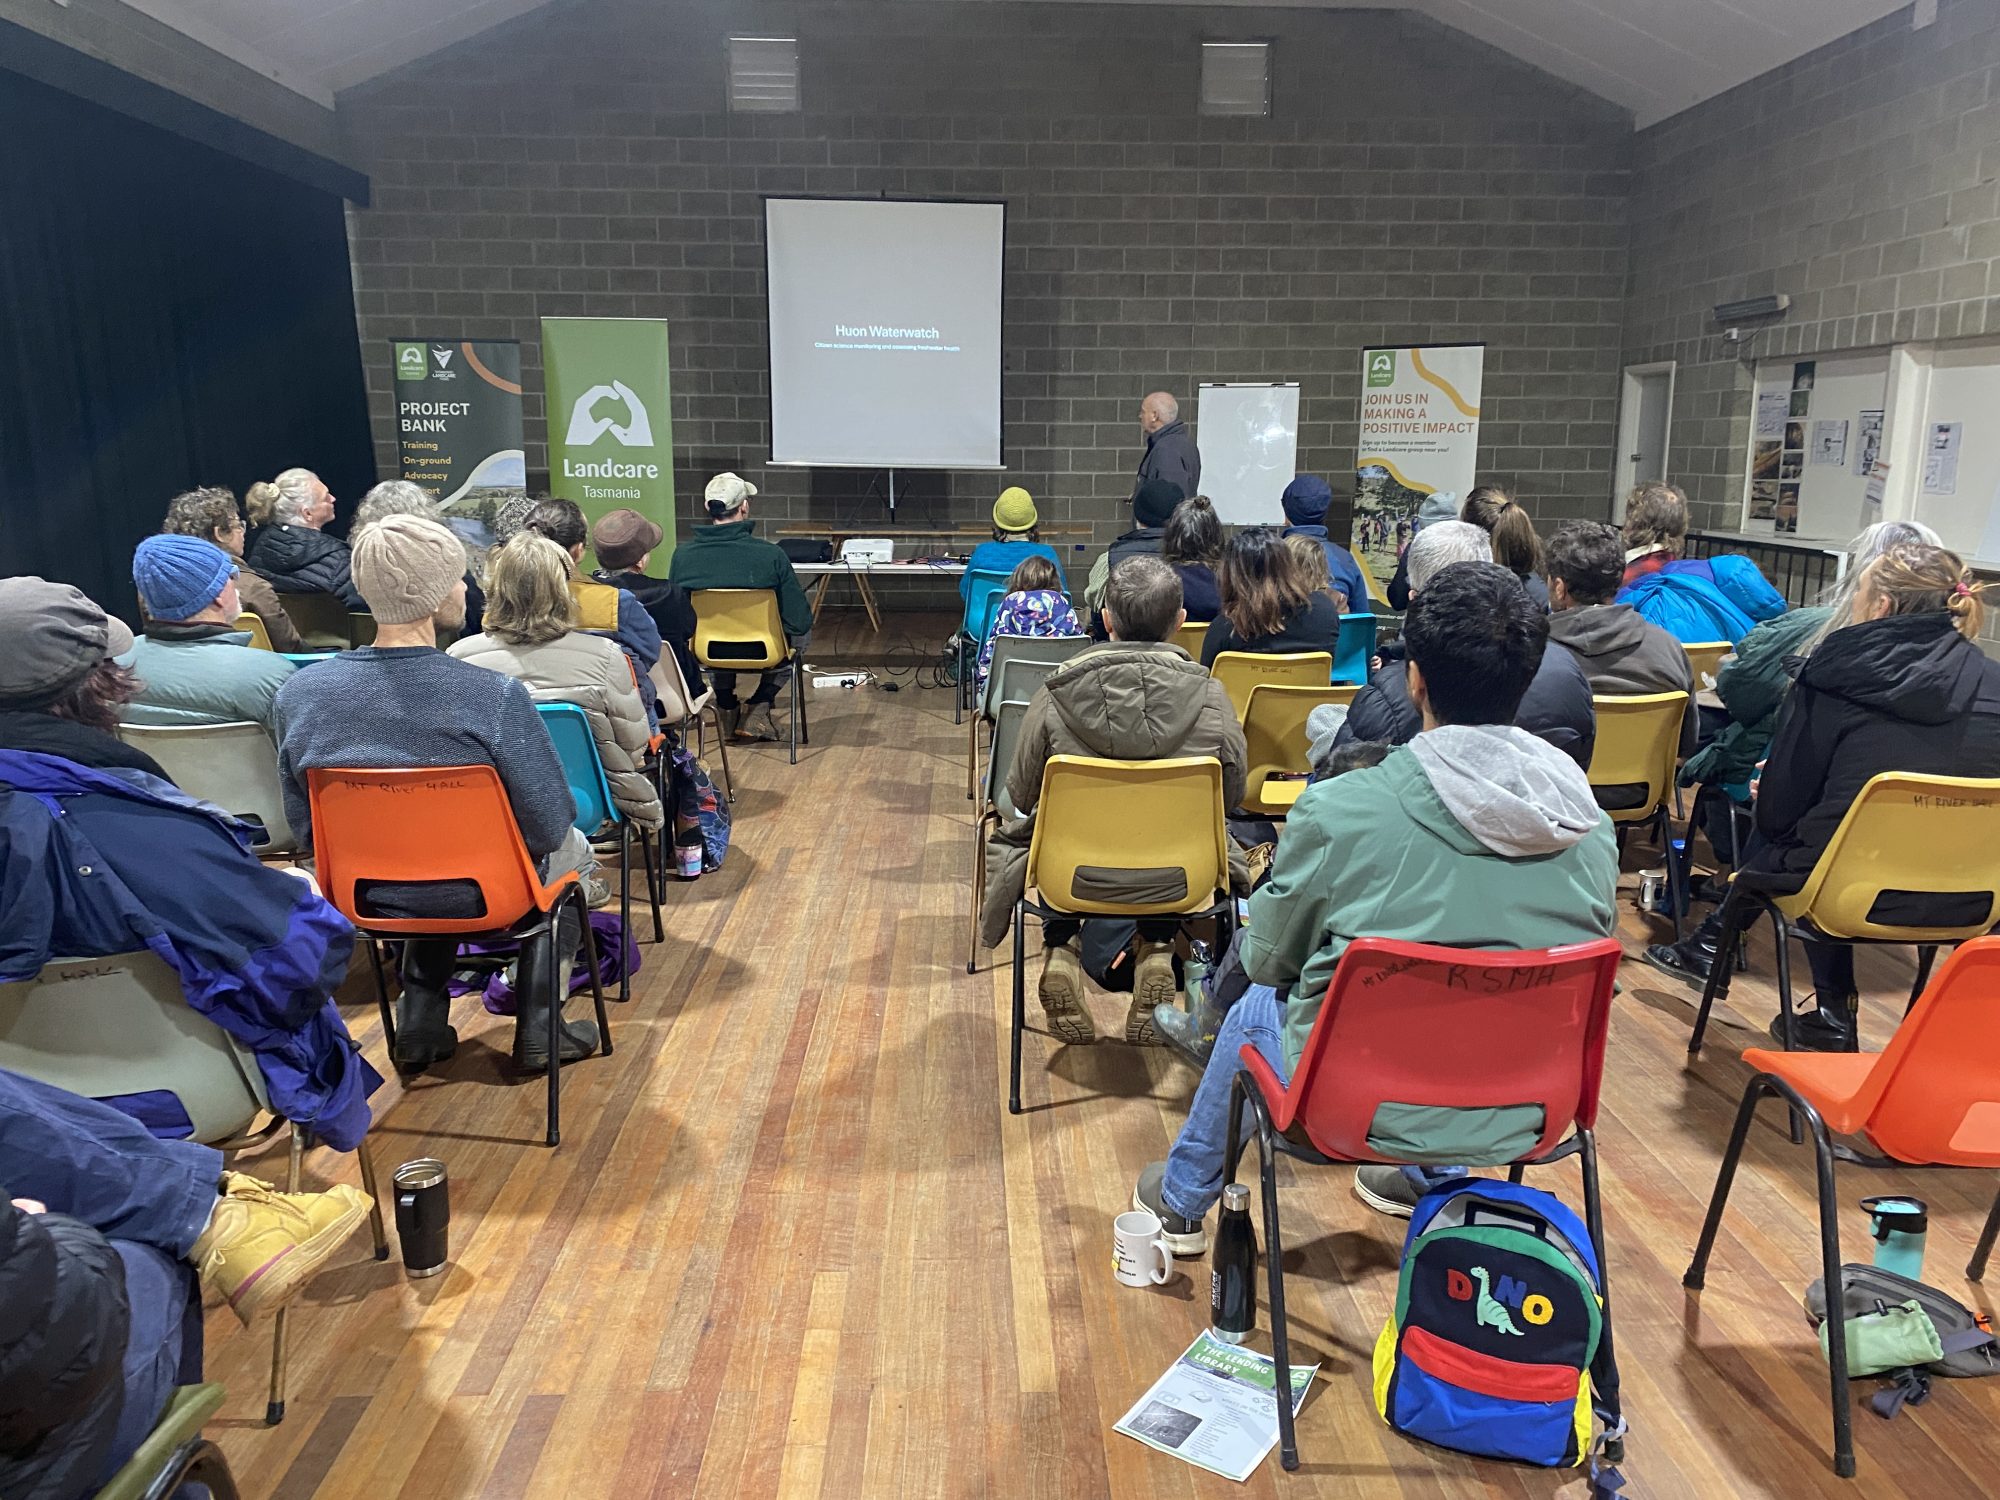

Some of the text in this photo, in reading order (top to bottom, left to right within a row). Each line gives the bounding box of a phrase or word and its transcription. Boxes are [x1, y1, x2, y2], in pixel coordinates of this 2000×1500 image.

[835, 325, 940, 339] Huon Waterwatch
[1365, 393, 1429, 405] JOIN US IN
[400, 403, 470, 416] PROJECT
[1364, 408, 1427, 420] MAKING A
[401, 419, 447, 432] BANK
[1363, 422, 1475, 434] POSITIVE IMPACT
[402, 441, 439, 451] Training
[403, 457, 452, 466] On-ground
[563, 458, 658, 479] Landcare
[404, 471, 448, 481] Advocacy
[582, 485, 641, 499] Tasmania
[1194, 1353, 1240, 1374] LIBRARY
[1203, 1344, 1270, 1374] THE LENDING
